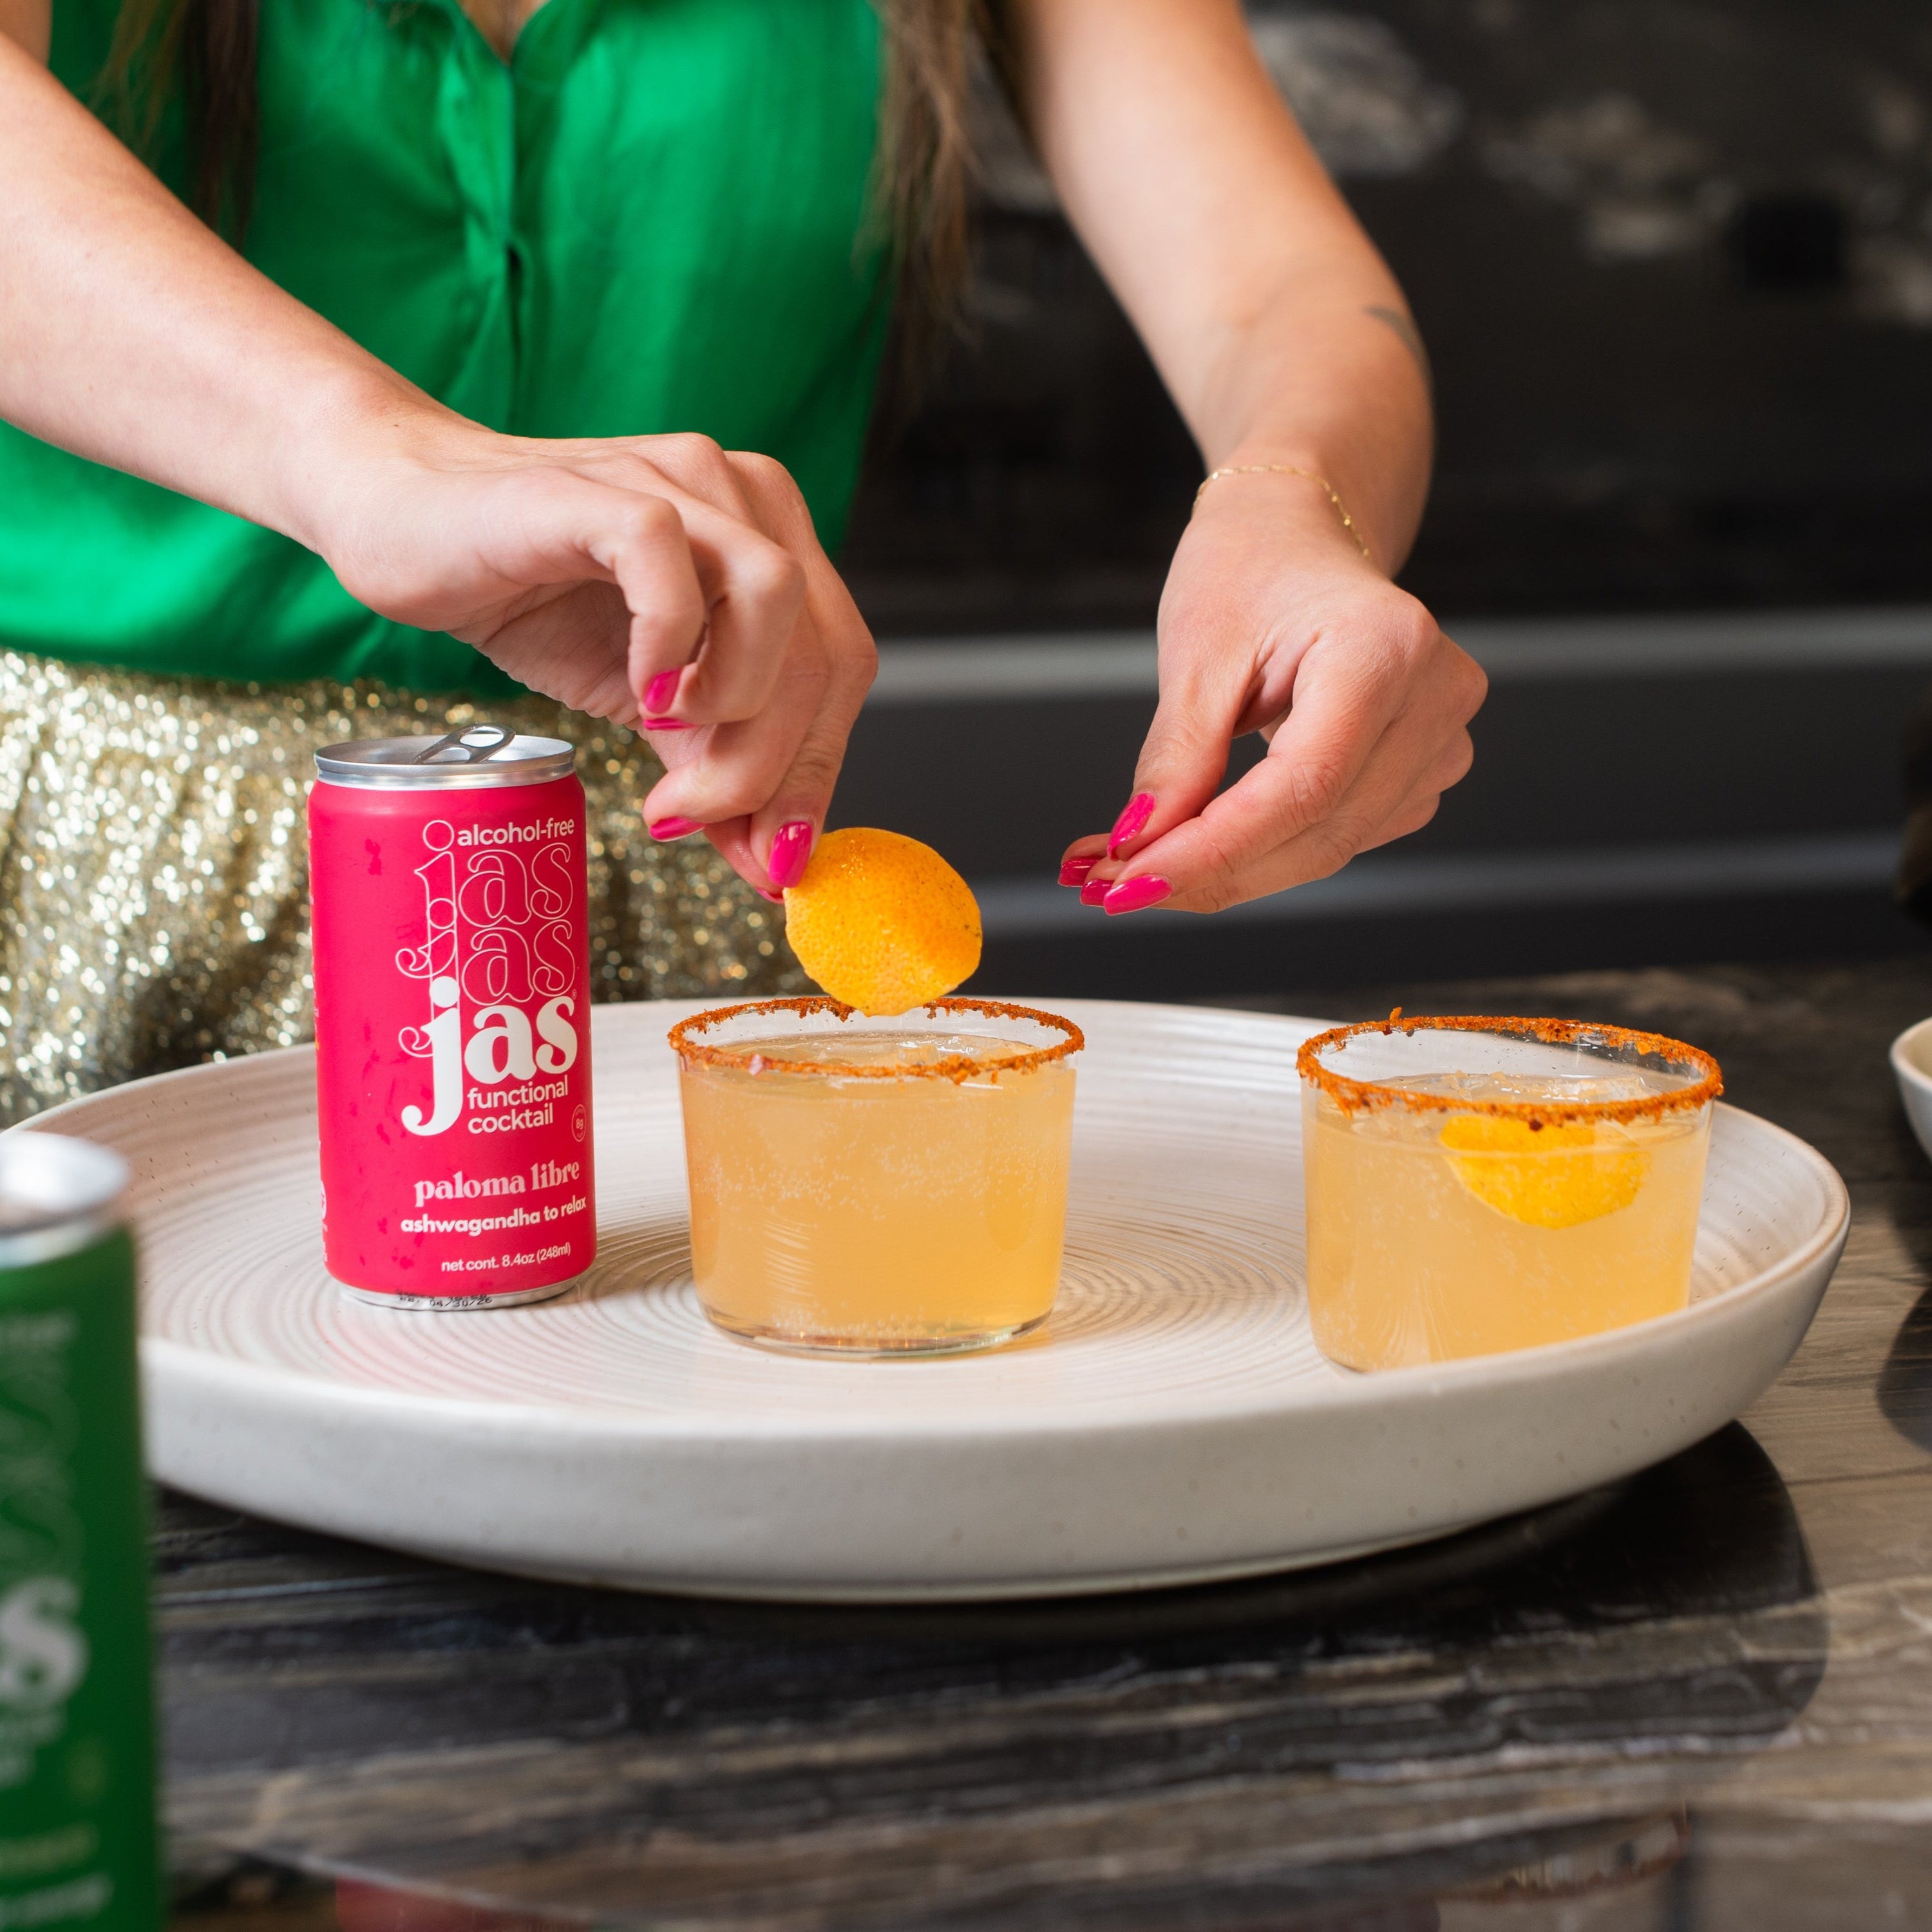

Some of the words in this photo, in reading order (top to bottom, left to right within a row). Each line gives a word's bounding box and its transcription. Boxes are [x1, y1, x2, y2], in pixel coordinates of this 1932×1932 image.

[457, 817, 575, 846] alcohol-free
[395, 819, 573, 979] jas
[399, 898, 576, 1057] jas
[401, 976, 578, 1136] jas
[467, 1075, 568, 1110] functional
[468, 1103, 554, 1134] cocktail
[414, 1171, 526, 1208] paloma
[530, 1159, 580, 1191] libre
[401, 1208, 541, 1237] ashwagandha
[544, 1206, 559, 1221] to
[561, 1195, 587, 1217] relax
[441, 1258, 464, 1272] net
[466, 1256, 499, 1271] cont.
[502, 1253, 535, 1267] 8.4oz
[536, 1242, 571, 1264] (248ml)
